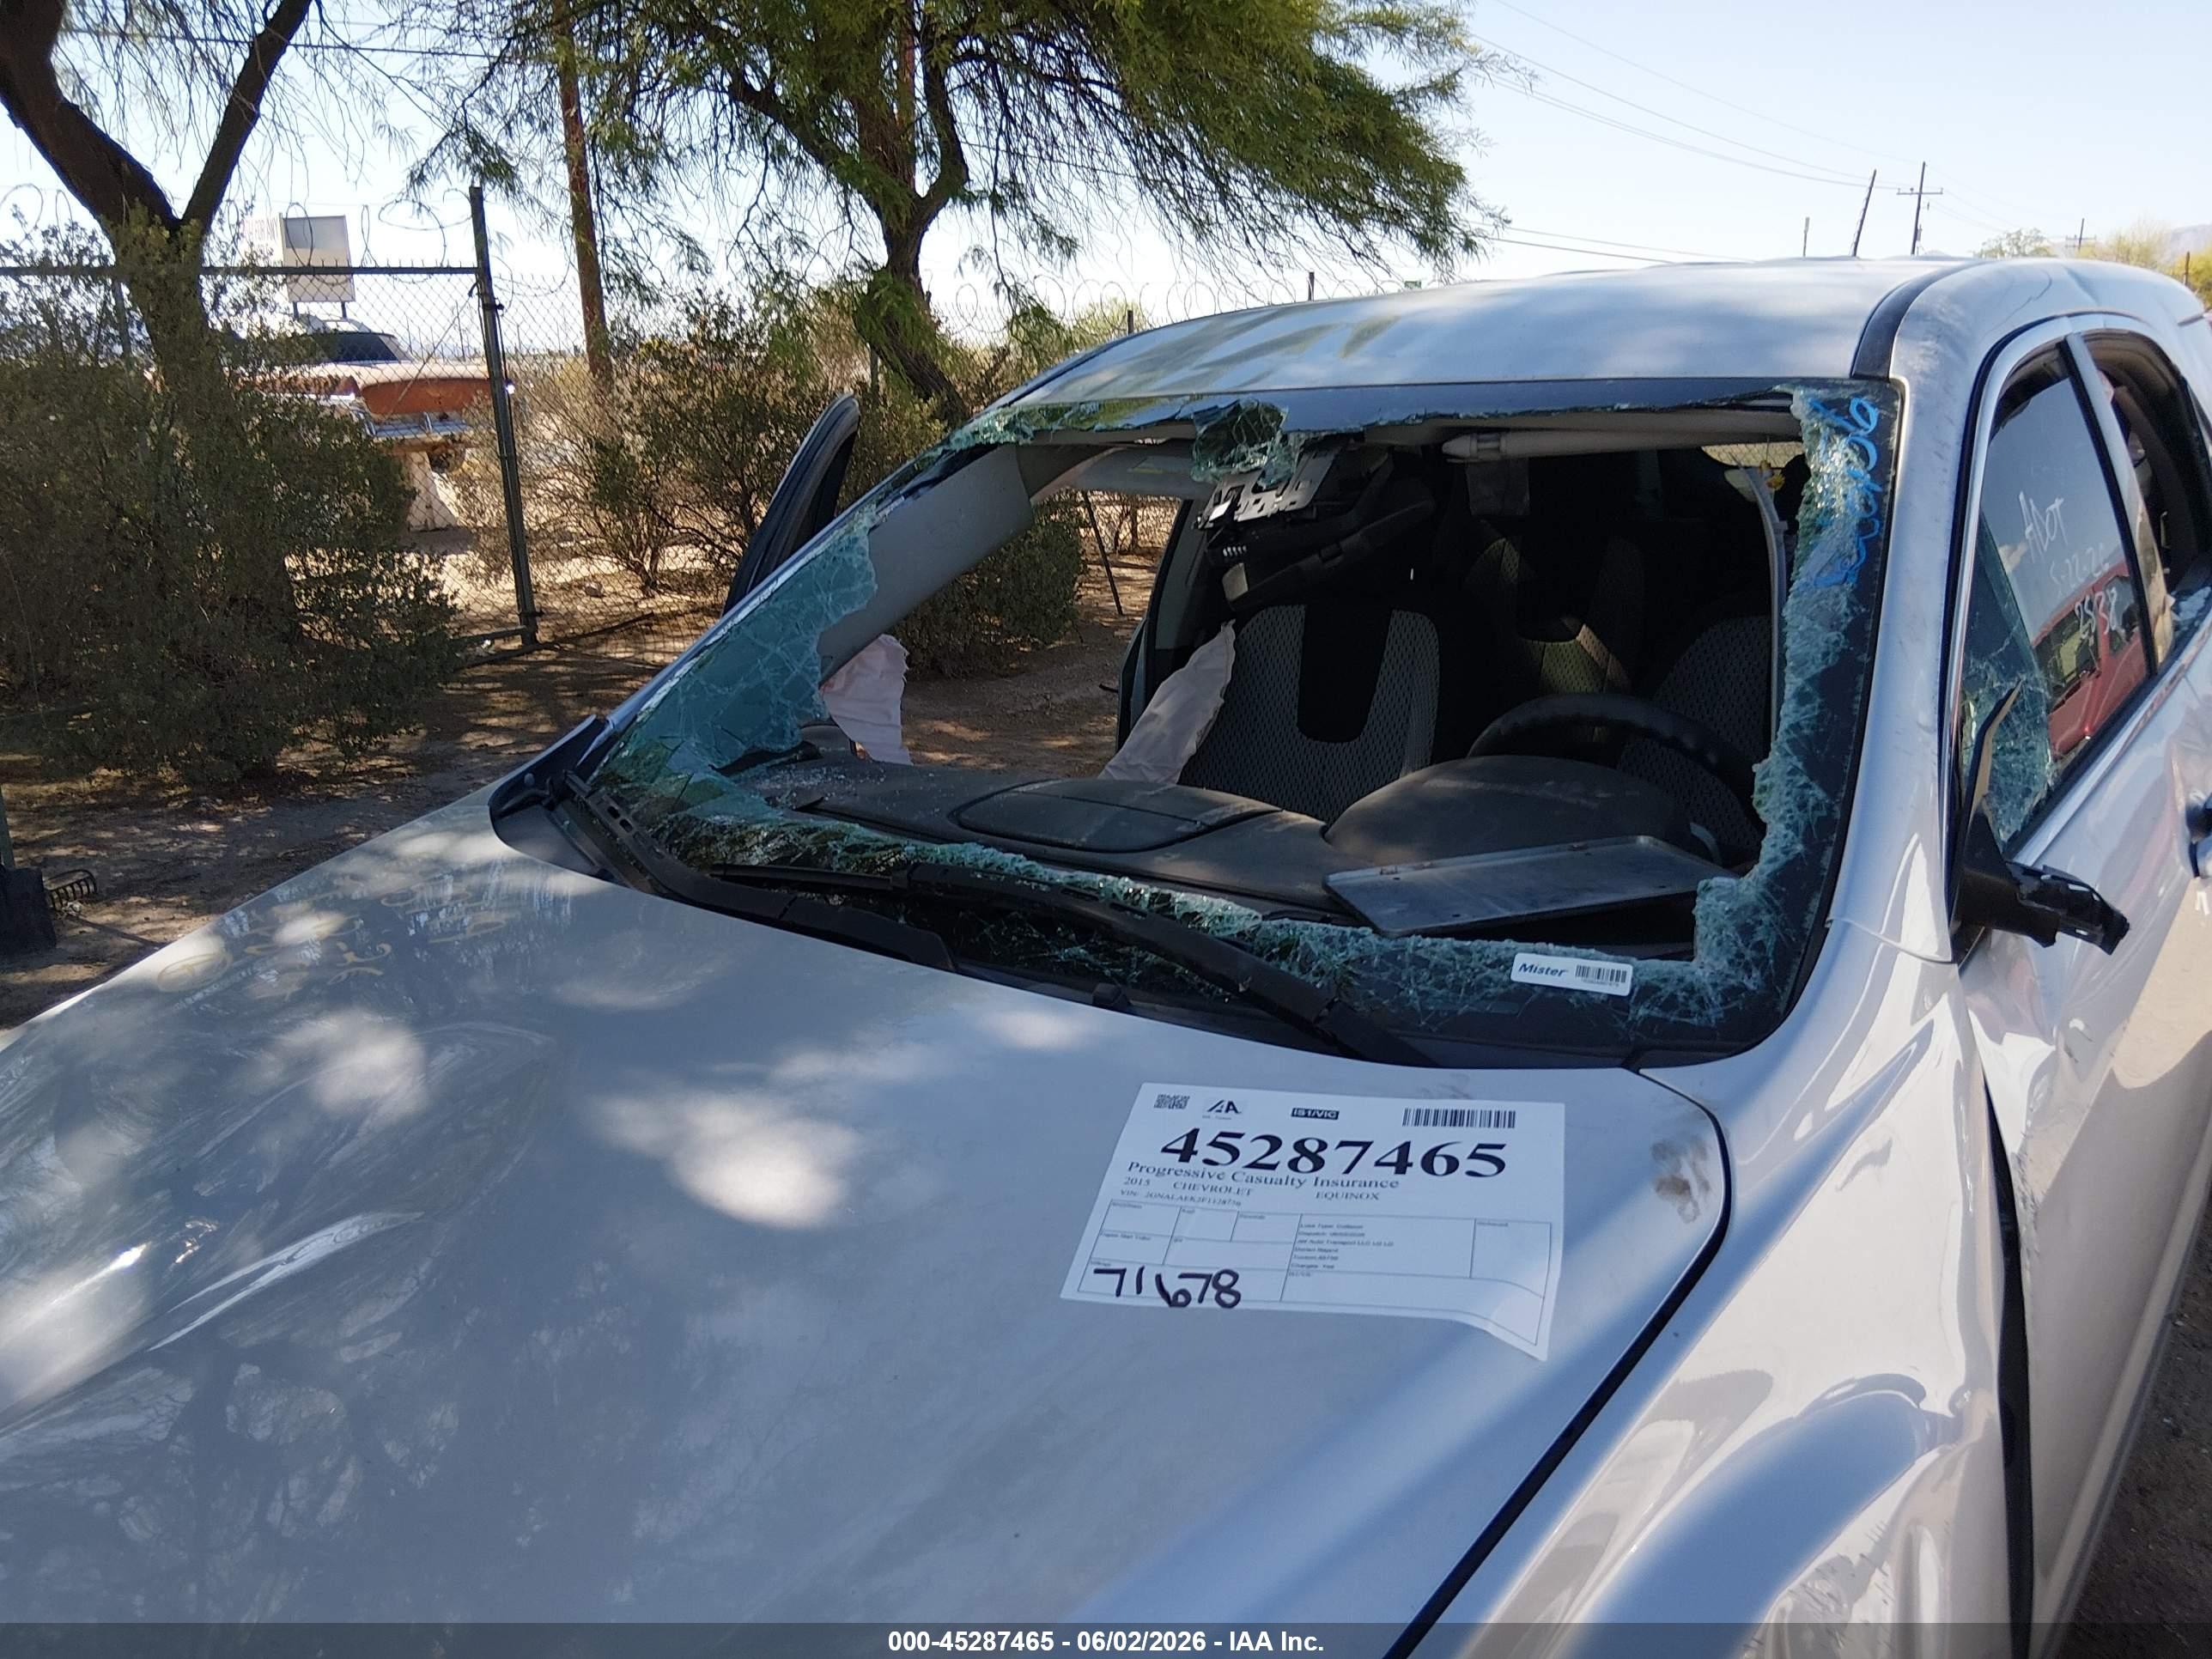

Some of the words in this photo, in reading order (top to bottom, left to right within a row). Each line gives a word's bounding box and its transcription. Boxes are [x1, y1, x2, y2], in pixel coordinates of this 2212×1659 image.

[1518, 962, 1567, 977] Mister
[1160, 1127, 1507, 1178] 45287465
[1123, 1176, 1151, 1187] 2015
[1173, 1181, 1254, 1197] CHEVROLET
[1316, 1191, 1381, 1201] EQUINOX
[1128, 1161, 1225, 1181] Progressive
[1231, 1172, 1307, 1189] Casualty
[1313, 1176, 1400, 1189] Insurance
[1093, 1265, 1242, 1309] 71678
